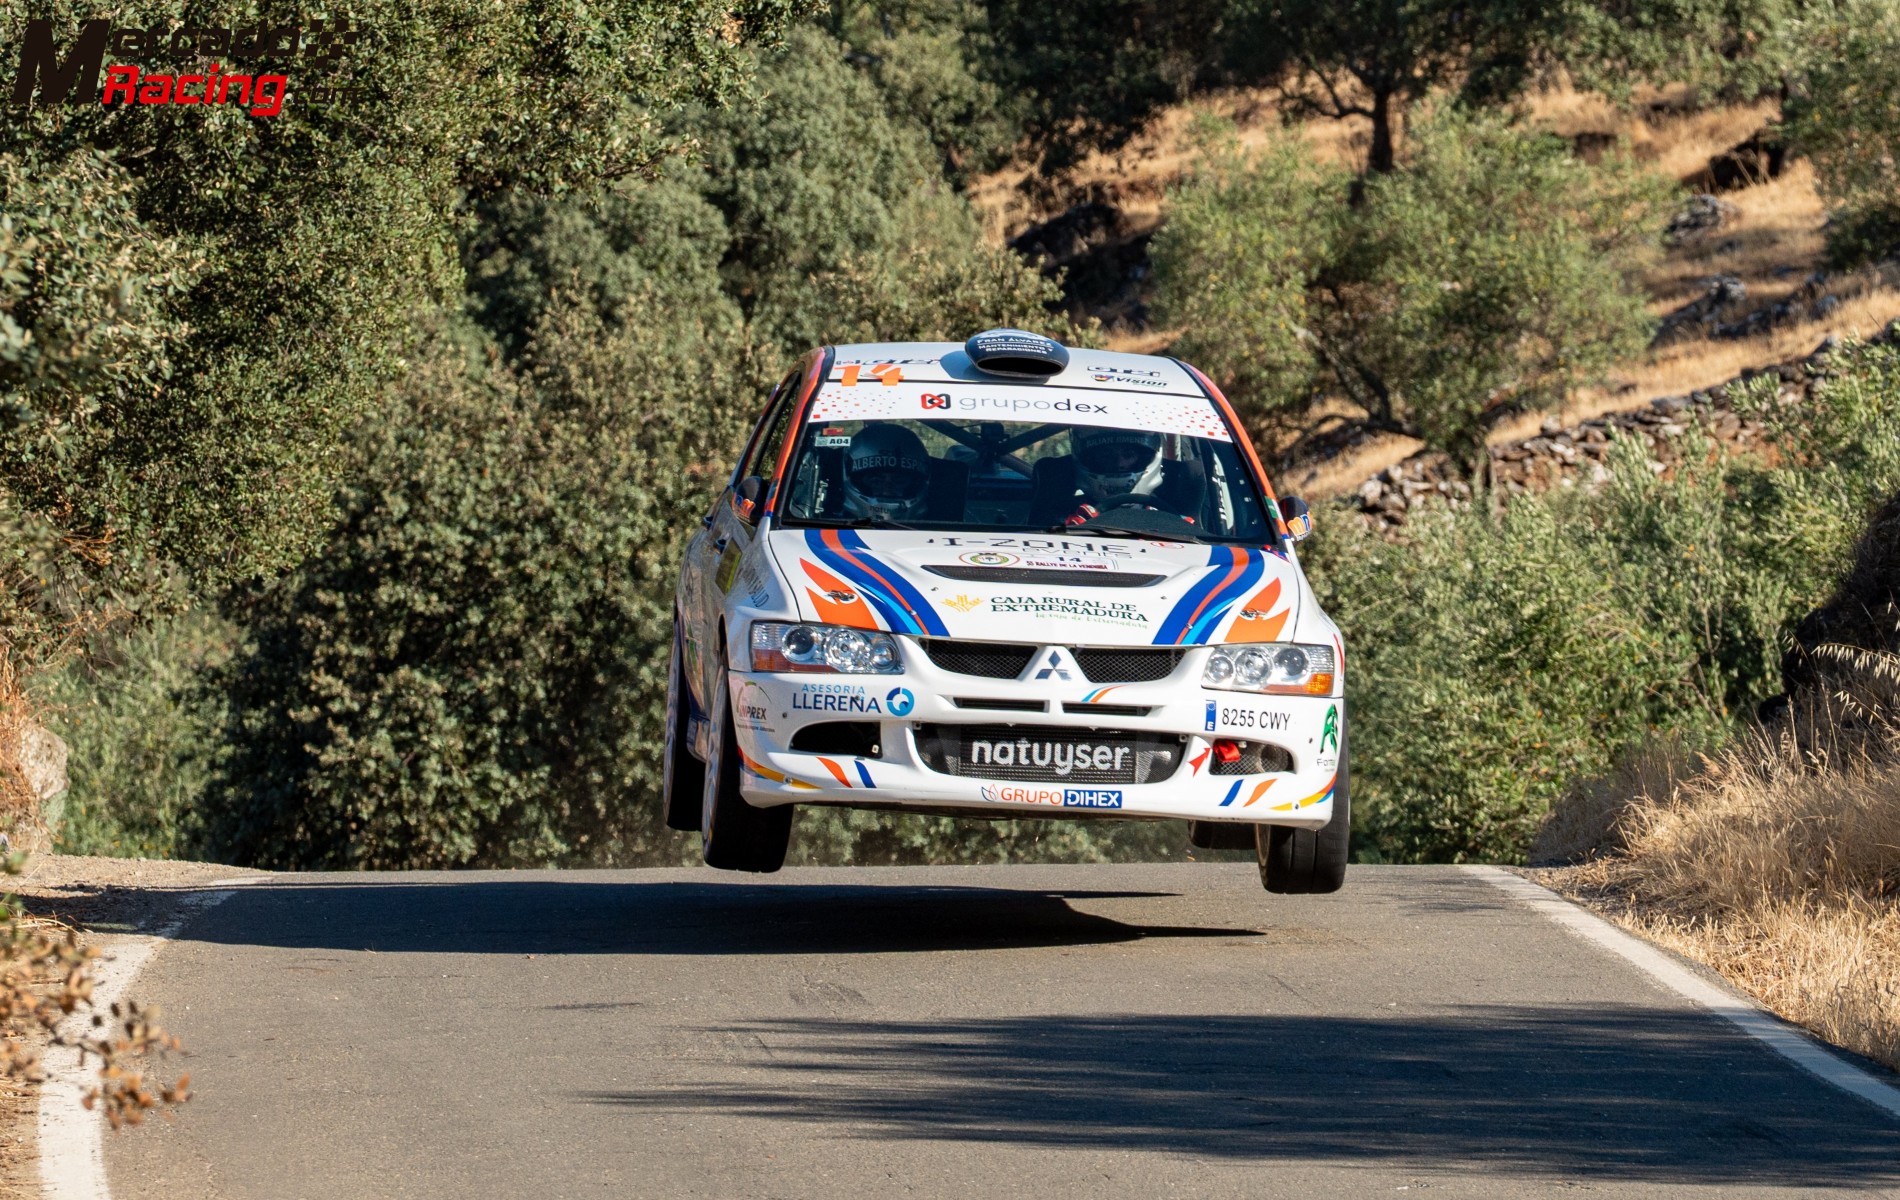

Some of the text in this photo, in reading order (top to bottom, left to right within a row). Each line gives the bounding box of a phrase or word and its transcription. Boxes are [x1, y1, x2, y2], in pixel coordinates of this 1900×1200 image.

[834, 364, 904, 386] 14
[1116, 376, 1168, 387] Vision
[959, 398, 1109, 414] grupodex
[851, 455, 898, 472] ALBERTO
[943, 538, 1131, 554] I-ZONE
[990, 596, 1137, 613] CAJA RURAL DE
[990, 604, 1149, 623] EXTREMADURA
[801, 683, 866, 695] ASESORIA
[792, 692, 882, 714] LLERENA
[739, 704, 767, 721] INPREX
[1222, 708, 1291, 731] 8255 CWY
[1207, 721, 1214, 730] E
[971, 737, 1130, 774] natuyser
[1000, 786, 1120, 807] GRUPO DIHEX
